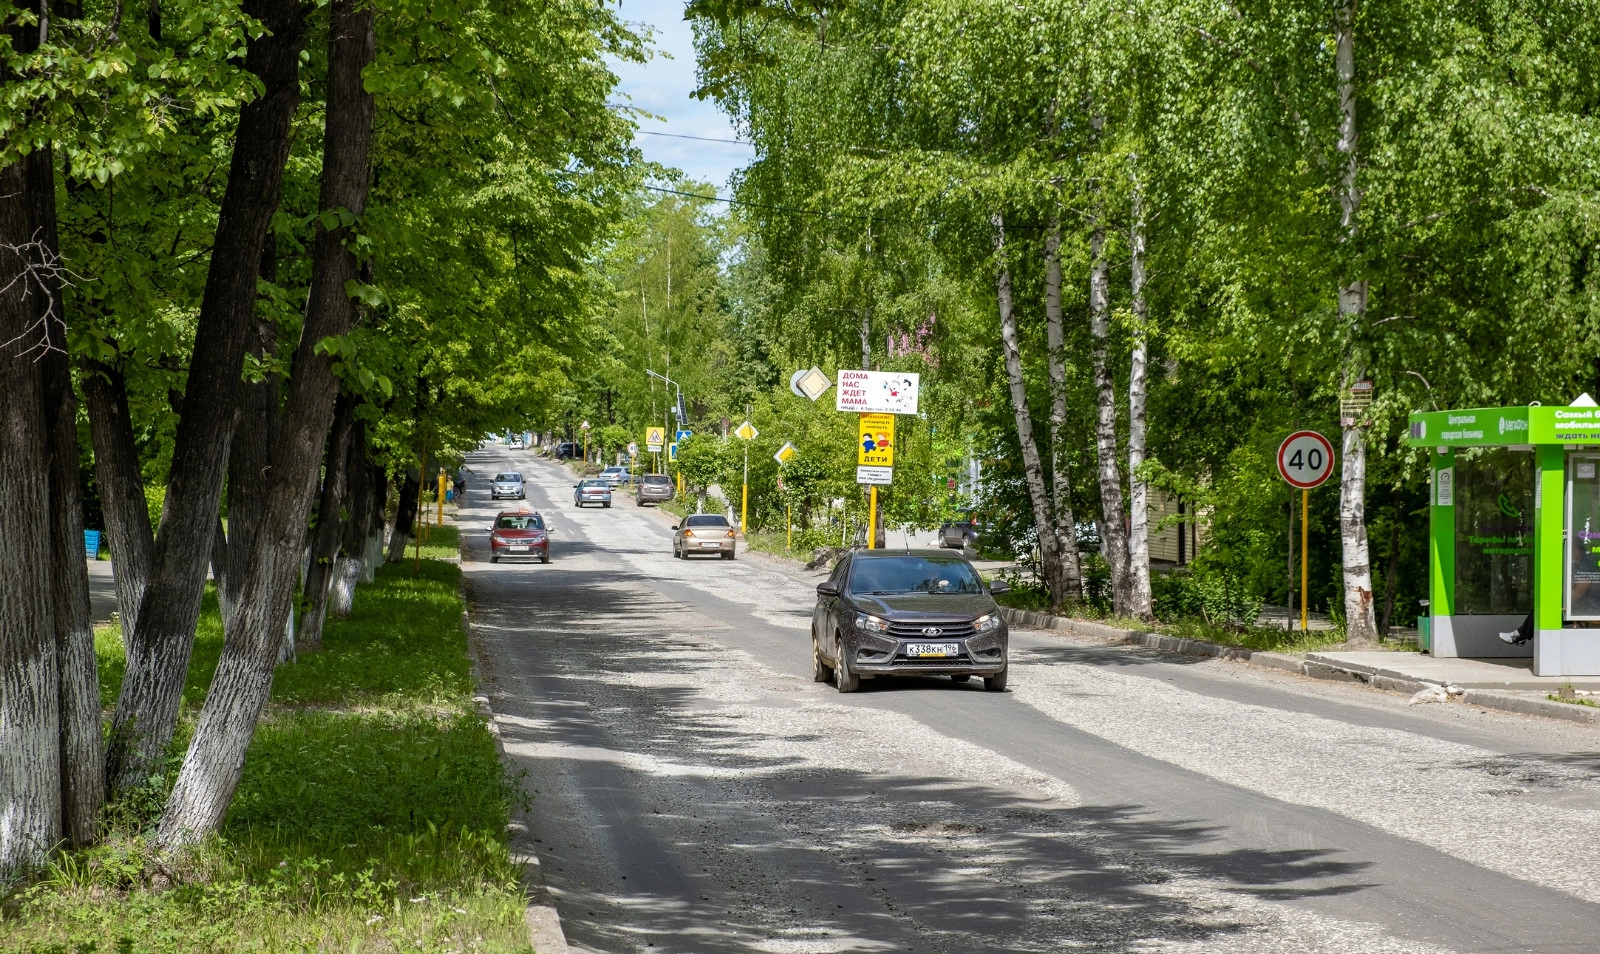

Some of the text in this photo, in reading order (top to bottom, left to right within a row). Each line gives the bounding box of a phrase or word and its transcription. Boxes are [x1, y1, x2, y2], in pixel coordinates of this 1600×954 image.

[843, 372, 868, 380] ДОМА
[842, 389, 866, 397] ЖДЕТ
[1555, 410, 1592, 418] Самый
[1555, 421, 1600, 429] мобильн
[1289, 448, 1322, 470] 40
[1468, 536, 1506, 544] Тарифы
[910, 645, 942, 653] К338КН
